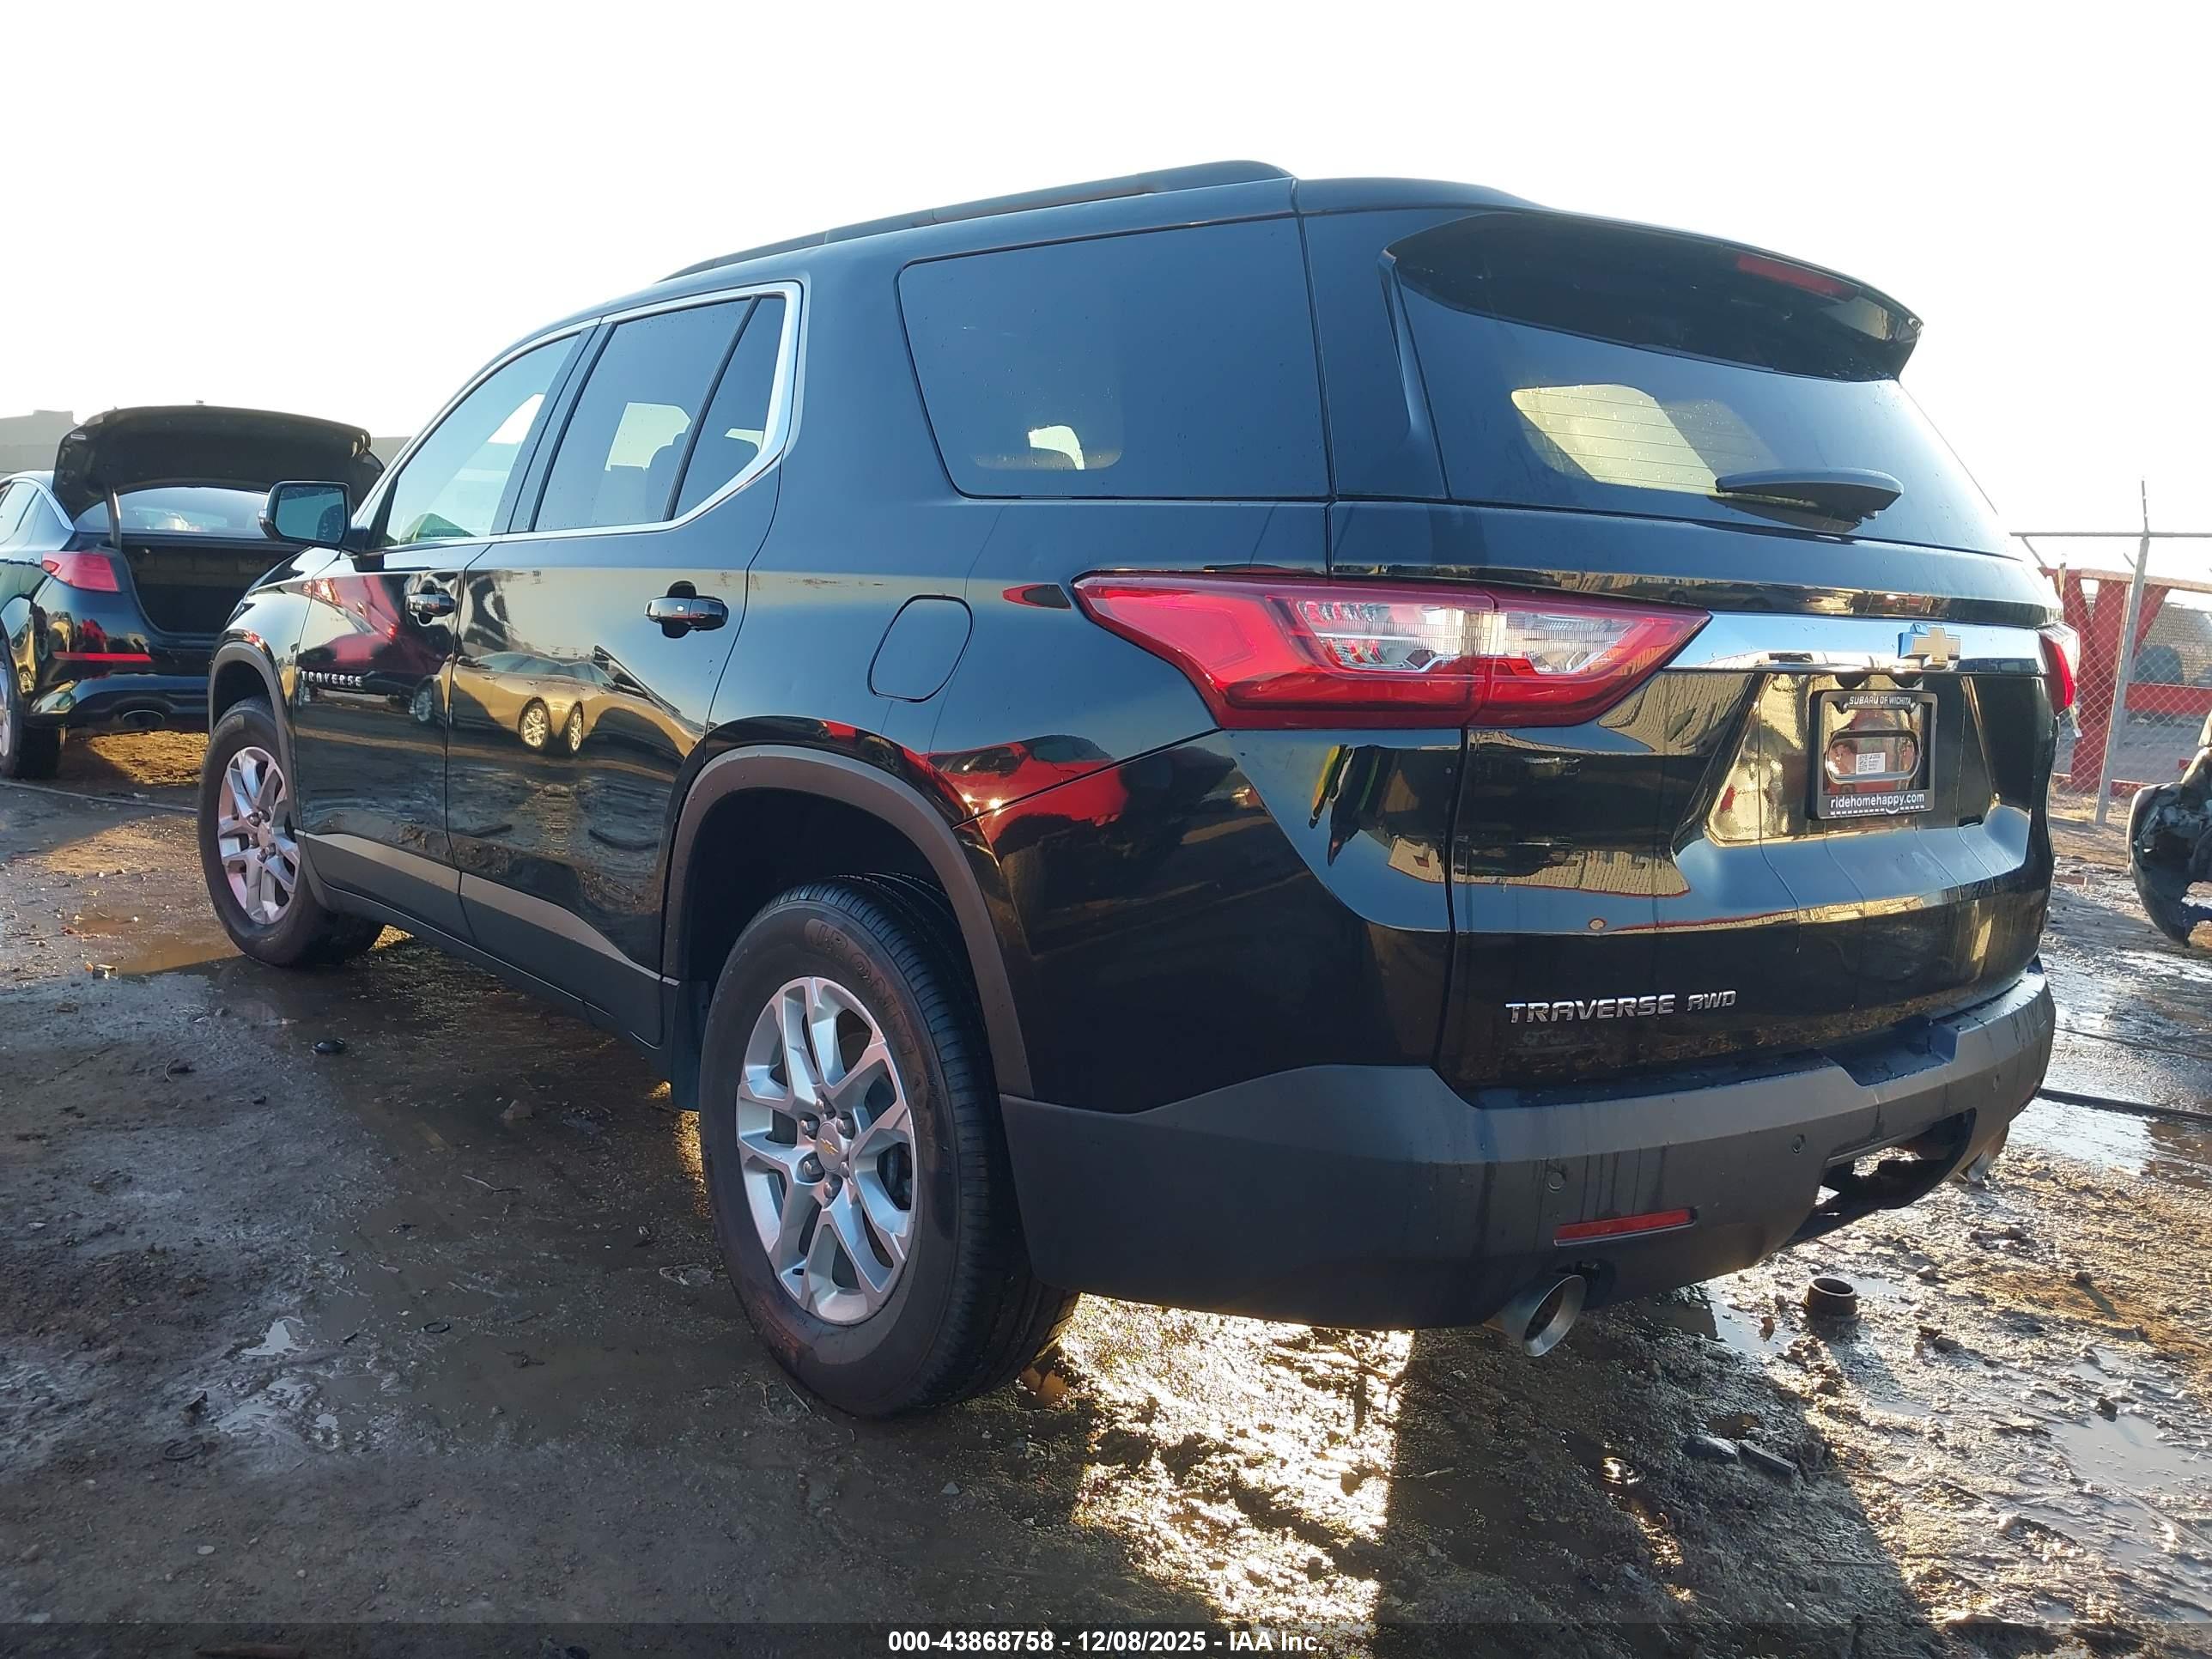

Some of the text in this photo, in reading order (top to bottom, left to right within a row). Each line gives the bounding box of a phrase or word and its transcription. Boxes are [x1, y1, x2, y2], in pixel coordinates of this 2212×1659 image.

[301, 671, 362, 686] TRAVERSE
[1849, 696, 1911, 706] SUBARU OF WICHITA
[1830, 793, 1925, 809] ridehomehappy.com
[1505, 990, 1737, 1024] TRAVERSE AWD
